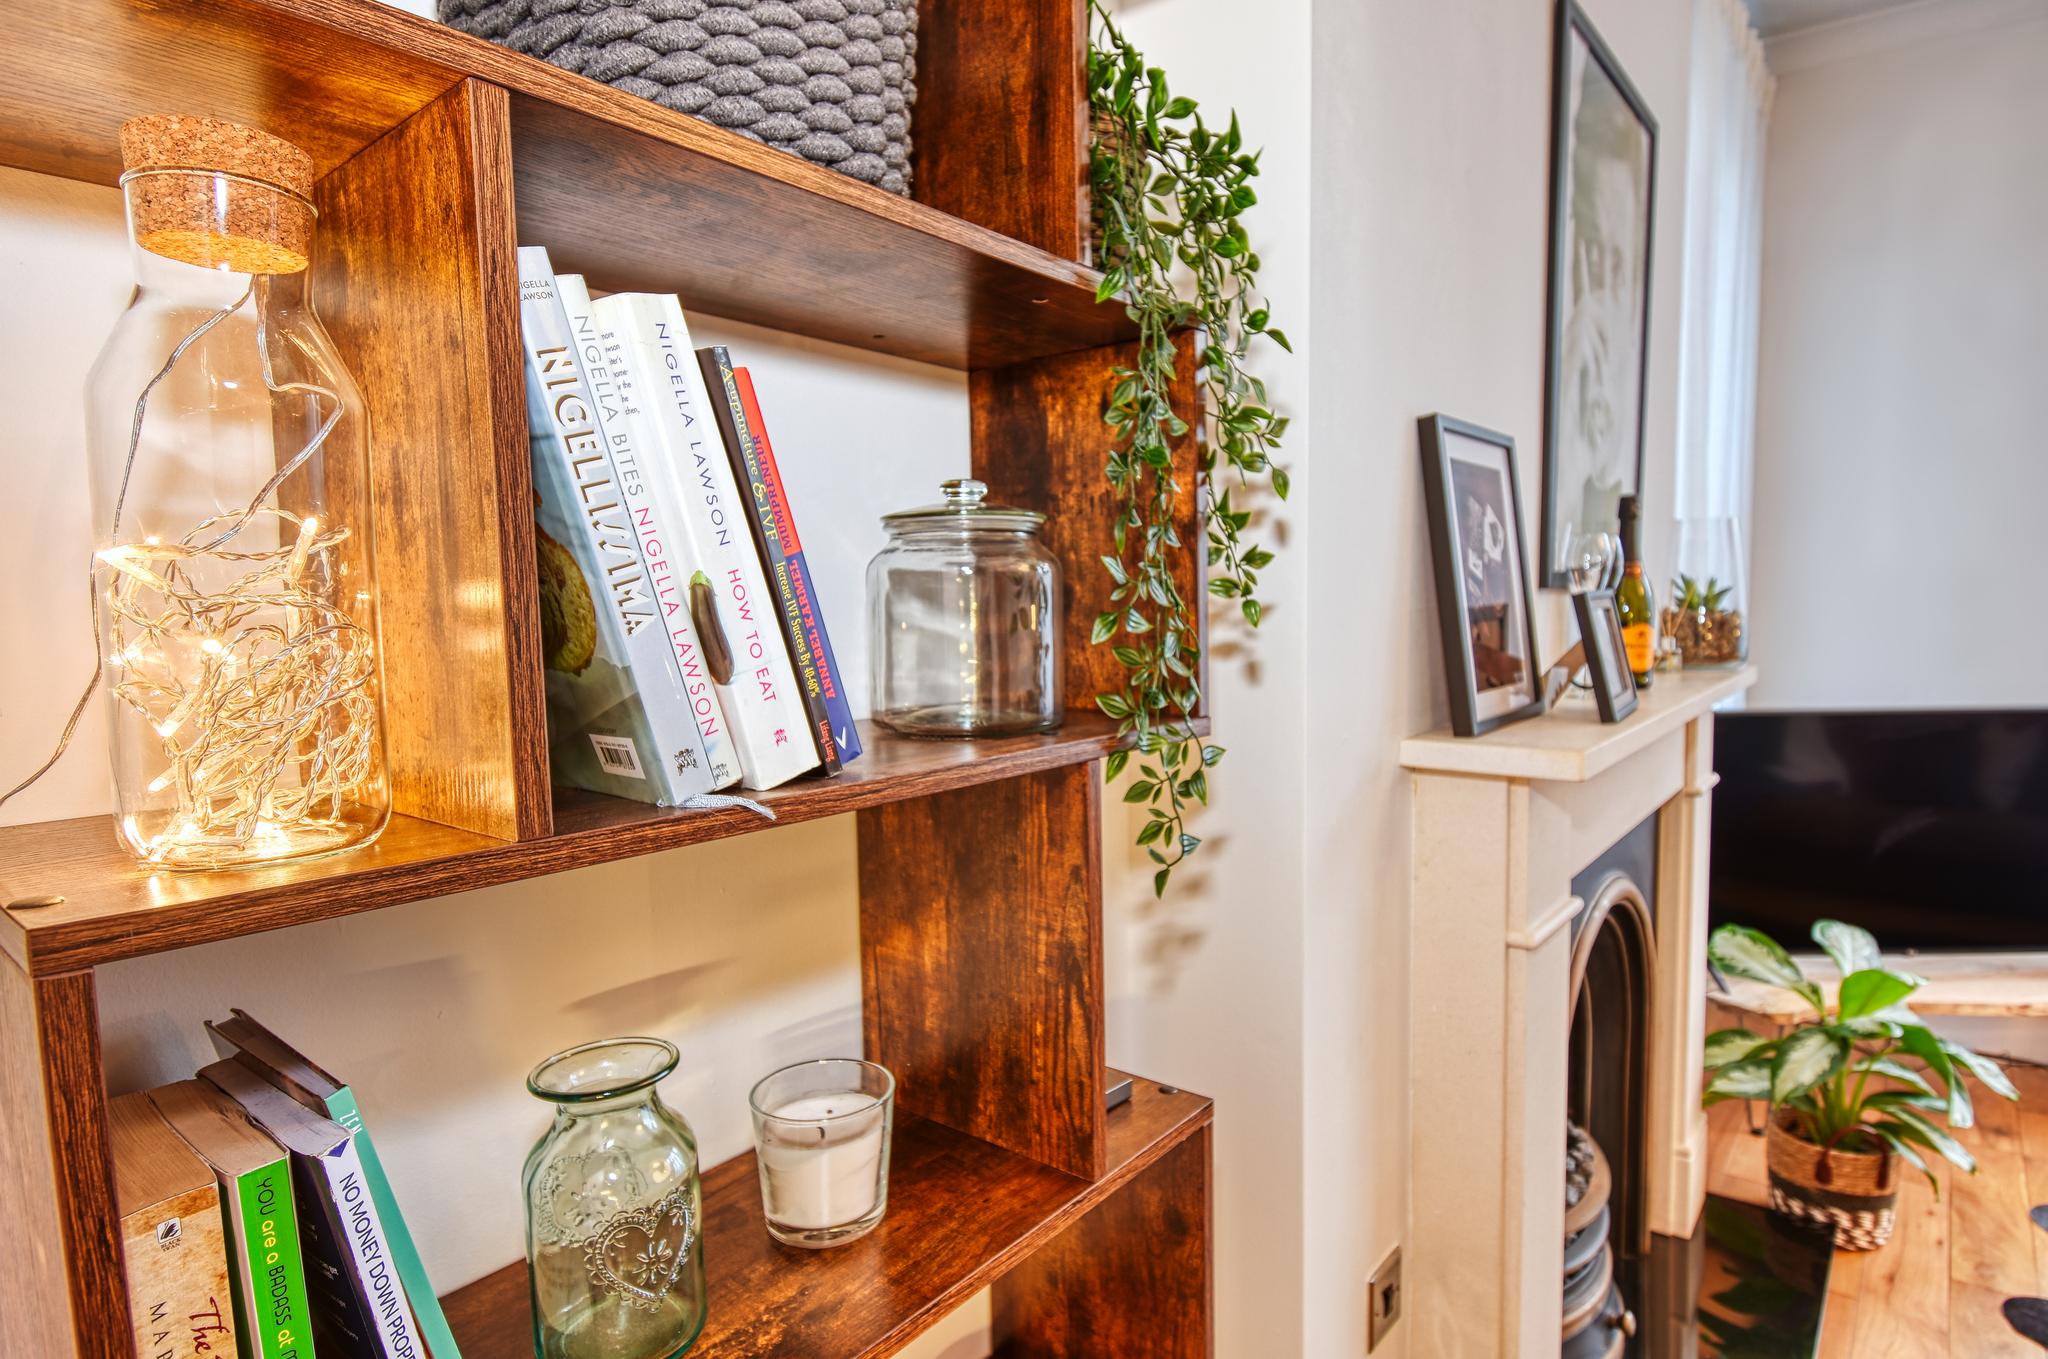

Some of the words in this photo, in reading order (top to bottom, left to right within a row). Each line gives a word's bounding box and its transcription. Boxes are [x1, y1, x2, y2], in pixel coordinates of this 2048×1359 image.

[519, 280, 551, 289] IGELLA
[574, 316, 619, 422] NIGELLA
[612, 433, 644, 496] BITES
[720, 364, 758, 476] Acupuncture
[656, 323, 694, 427] NIGELLA
[690, 441, 731, 546] LAWSON
[536, 346, 657, 637] NIGELLISSIMA
[752, 482, 767, 502] &
[752, 434, 792, 550] MUMPRENEUR
[759, 505, 777, 541] IVF
[776, 561, 791, 599] Increase
[788, 559, 816, 629] KARMEL
[635, 507, 680, 617] NIGELLA
[673, 628, 719, 737] LAWSON
[786, 600, 800, 617] IVF
[727, 568, 753, 621] HOW
[746, 630, 762, 658] TO
[756, 667, 777, 702] EAT
[791, 618, 806, 653] Success
[799, 652, 811, 666] By
[808, 628, 836, 699] ANNABEL
[256, 1177, 276, 1216] YOU
[339, 1172, 361, 1203] NO
[262, 1220, 277, 1248] are
[266, 1252, 279, 1264] a
[348, 1200, 382, 1264] MONEY
[269, 1265, 291, 1326] BADASS
[369, 1261, 400, 1320] DOWN
[189, 1296, 230, 1355] The
[278, 1329, 295, 1349] at
[387, 1314, 416, 1359] PROP
